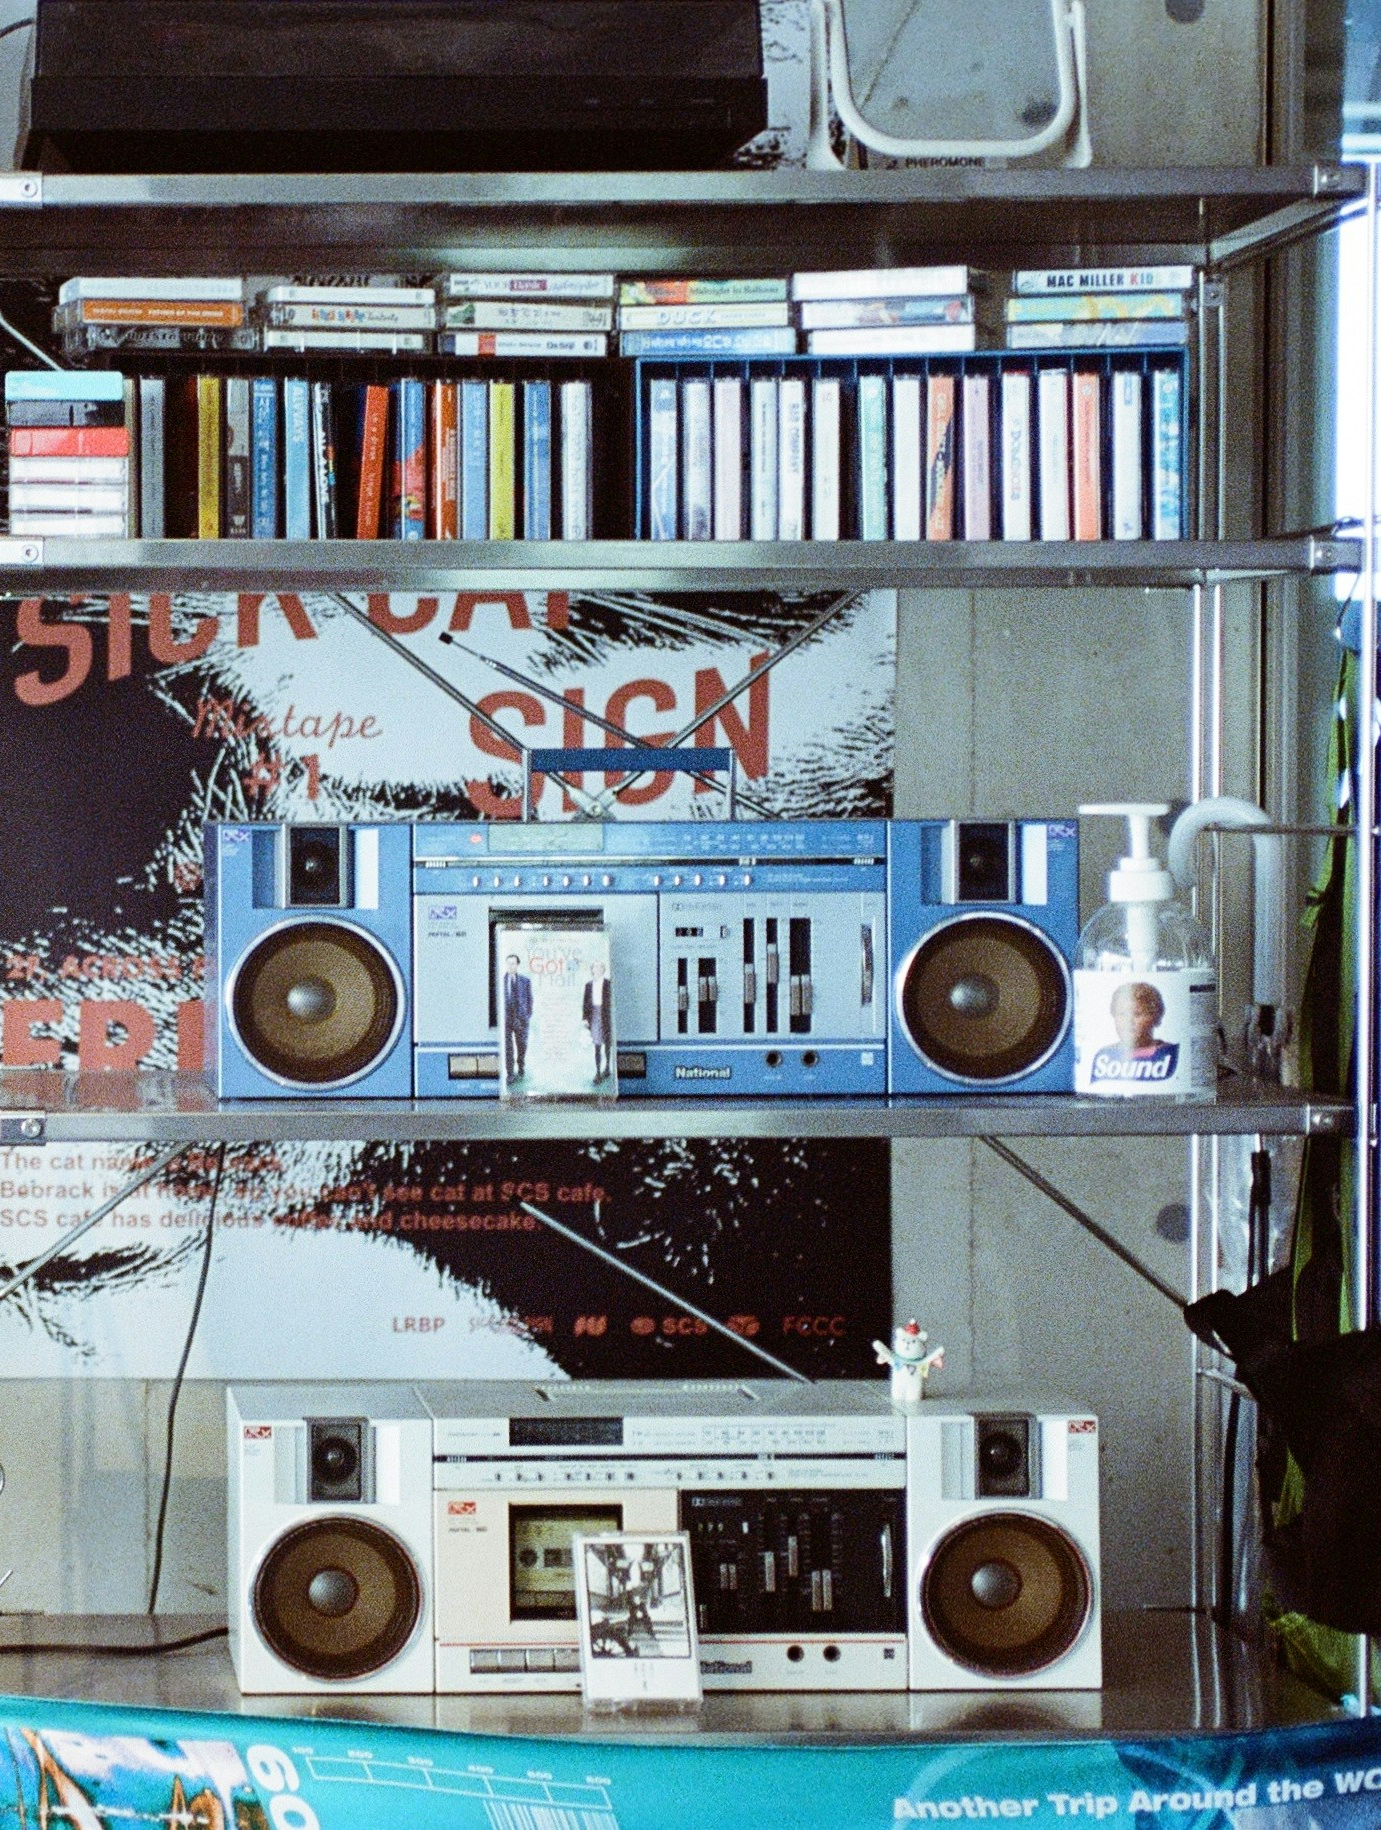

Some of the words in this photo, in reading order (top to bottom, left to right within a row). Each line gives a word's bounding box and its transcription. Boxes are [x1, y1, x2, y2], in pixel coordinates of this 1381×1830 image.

[1046, 273, 1075, 288] MAC
[1079, 272, 1125, 287] MILLER
[189, 692, 385, 748] Mixtape
[468, 651, 771, 819] SIGN
[674, 1065, 731, 1080] National
[1094, 1055, 1171, 1080] Sound
[1, 1152, 41, 1170] The
[49, 1153, 84, 1170] cat
[1, 1180, 94, 1198] Bebrack
[383, 1184, 423, 1202] see
[429, 1182, 466, 1202] cat
[471, 1183, 495, 1202] at
[499, 1181, 550, 1202] SCS
[0, 1209, 49, 1228] SCS
[112, 1209, 152, 1228] has
[392, 1316, 446, 1334] LRBP
[700, 1659, 753, 1675] ational
[893, 1793, 1038, 1820] Another
[1047, 1792, 1119, 1819] Trip
[1129, 1783, 1258, 1814] Around
[1267, 1778, 1324, 1804] the
